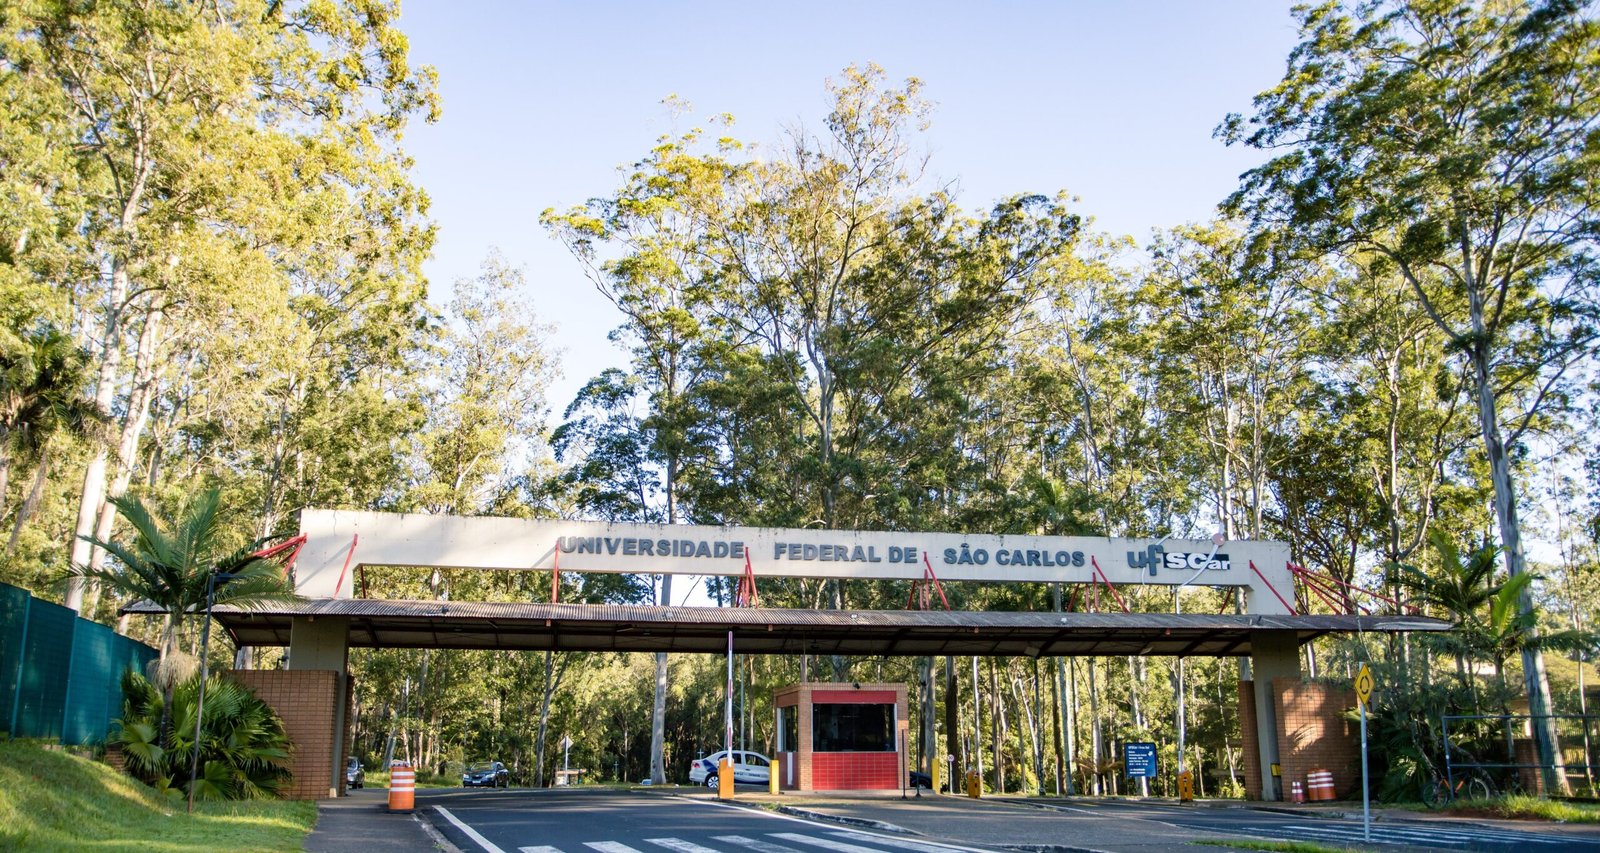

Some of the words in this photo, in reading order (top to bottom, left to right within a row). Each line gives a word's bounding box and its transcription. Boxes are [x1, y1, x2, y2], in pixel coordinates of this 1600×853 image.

[559, 536, 745, 559] UNIVERSIDADE
[774, 542, 881, 562] FEDERAL
[888, 546, 918, 564] DE
[943, 542, 989, 566] SÃO
[995, 549, 1086, 568] CARLOS
